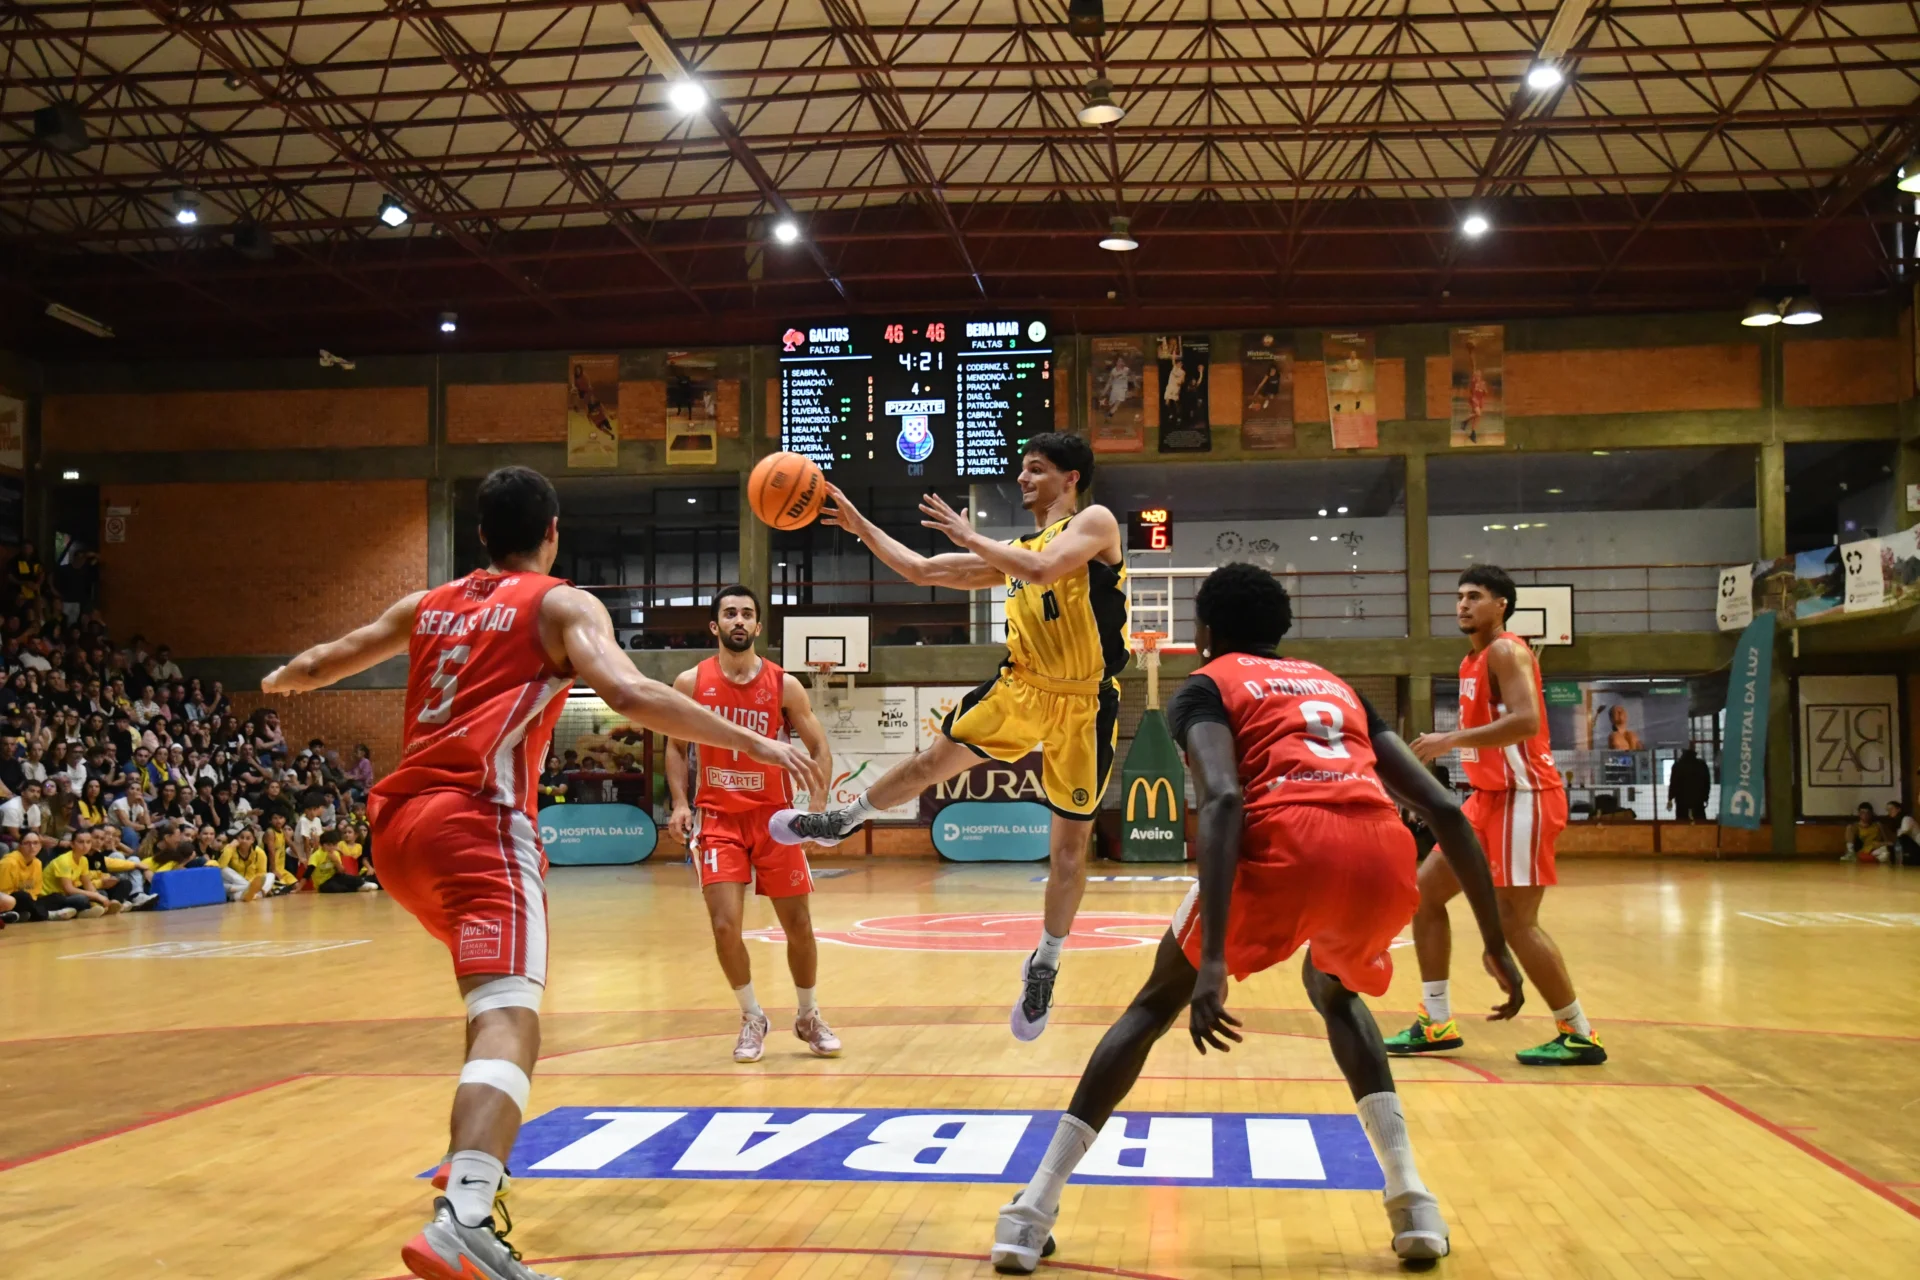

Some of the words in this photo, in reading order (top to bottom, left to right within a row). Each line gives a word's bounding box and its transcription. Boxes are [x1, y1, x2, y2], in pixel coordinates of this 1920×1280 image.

[809, 327, 850, 342] GALITOS
[884, 324, 904, 343] 46
[926, 323, 945, 342] 46
[966, 322, 995, 337] BEIRA
[996, 321, 1019, 336] MAR
[809, 346, 840, 354] FALTAS
[848, 345, 852, 354] 1
[972, 340, 1002, 348] FALTAS
[1010, 339, 1016, 348] 3
[899, 352, 943, 371] 4:21
[957, 364, 962, 372] 4
[783, 380, 788, 388] 2
[912, 382, 919, 395] 4
[868, 404, 873, 412] 2
[888, 403, 942, 413] PIZZARTE
[966, 400, 1010, 409] PATROCÍNIO,
[1044, 399, 1050, 407] 2
[957, 412, 962, 420] 9
[956, 421, 964, 429] 10
[957, 468, 964, 476] 17
[1152, 526, 1166, 548] 6
[1041, 590, 1060, 622] 10
[1746, 647, 1759, 678] LUZ
[418, 645, 471, 724] 5
[1243, 680, 1269, 699] D.
[1744, 681, 1756, 703] DA
[1299, 700, 1350, 759] 9
[1813, 708, 1884, 742] ZIG
[1740, 706, 1755, 786] HOSPITAL
[1815, 739, 1884, 772] ZAG
[560, 827, 607, 836] HOSPITAL
[609, 827, 623, 835] DA
[625, 827, 644, 835] LUZ
[962, 825, 1010, 834] HOSPITAL
[1012, 825, 1026, 834] DA
[1029, 825, 1048, 833] LUZ
[1130, 827, 1173, 840] Aveiro
[704, 848, 718, 872] 4
[527, 1111, 1327, 1181] IRBAL
